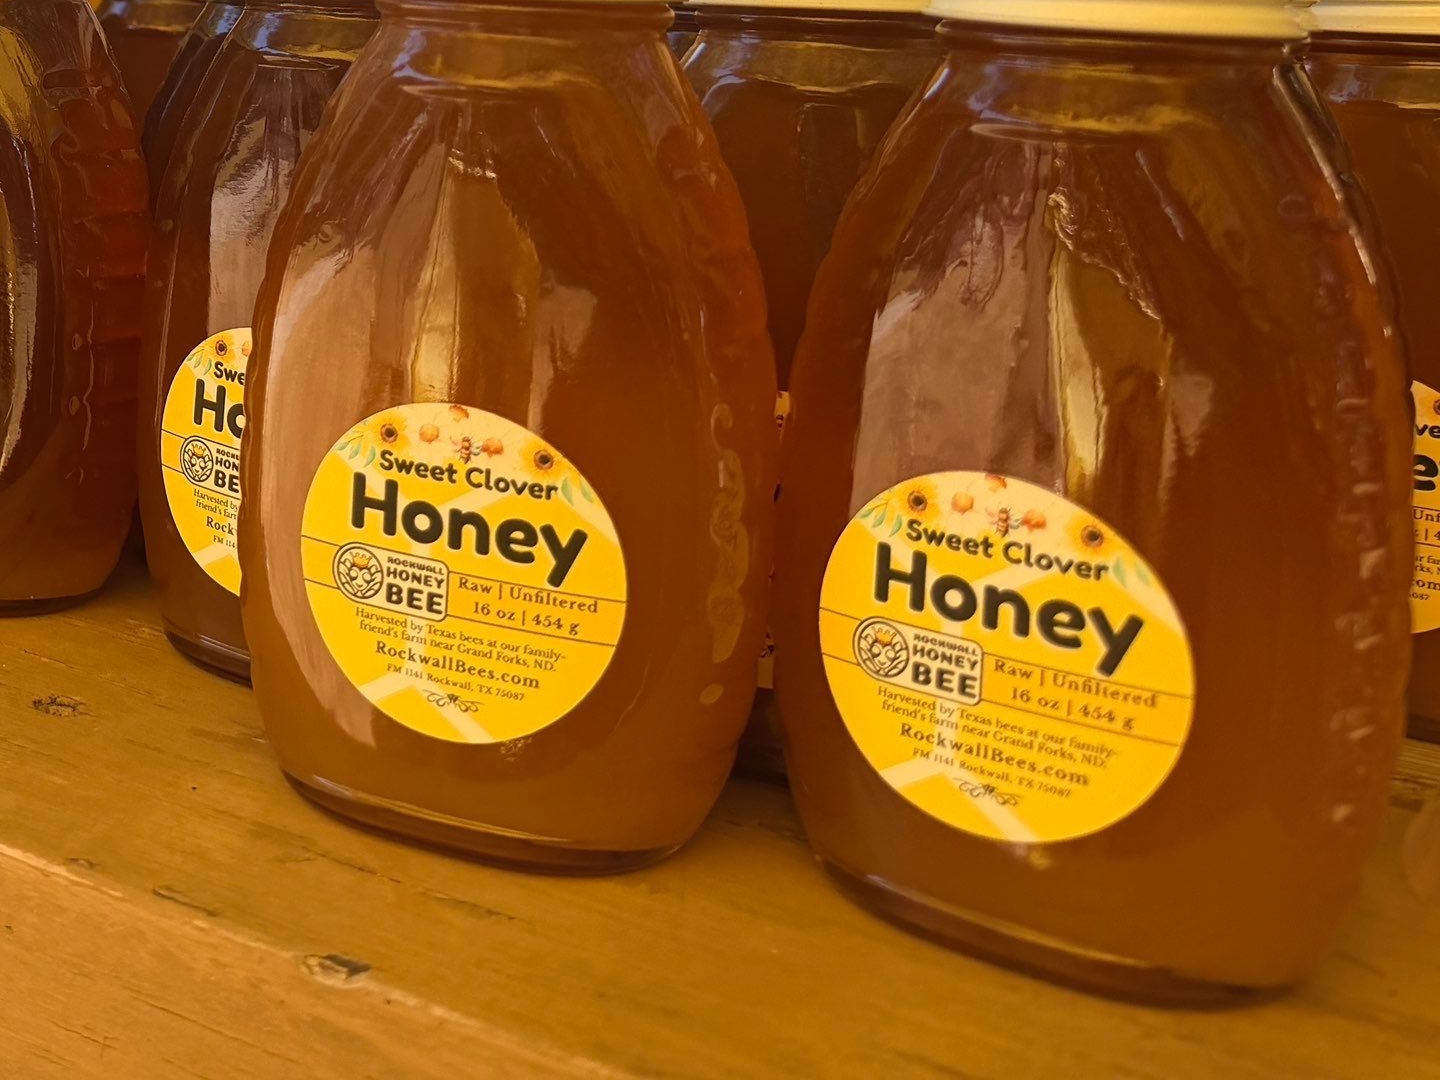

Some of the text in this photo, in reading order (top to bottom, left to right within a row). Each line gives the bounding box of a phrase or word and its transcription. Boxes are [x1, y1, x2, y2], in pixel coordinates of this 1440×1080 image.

[213, 360, 244, 385] Swe
[214, 469, 240, 493] BE
[215, 456, 241, 474] HON
[379, 449, 558, 500] Sweet Clover
[193, 488, 228, 508] Harvested
[195, 498, 222, 515] friend's
[351, 472, 588, 588] Honey
[387, 556, 444, 575] ROCKWALL
[906, 518, 1109, 581] Sweet Clover
[386, 566, 444, 589] HONEY
[458, 576, 598, 613] Raw Unfiltered
[386, 582, 443, 614] BEE
[874, 542, 1144, 677] Honey
[355, 606, 566, 663] Harvested by Texas bees at our family-
[473, 601, 579, 636] 16 oz 454 g
[359, 619, 556, 672] friend's farm near Grand Forks, ND.
[912, 644, 978, 671] HONEY
[913, 633, 977, 656] ROCKWALL
[375, 640, 539, 689] RockwallBees.com
[386, 663, 402, 673] FM
[427, 672, 473, 691] Rockwall,
[477, 684, 492, 695] TX
[912, 661, 977, 698] BEE
[994, 659, 1158, 708] Raw Unfiltered
[877, 685, 936, 712] Harvested
[959, 708, 992, 726] Texas
[1012, 687, 1031, 703] 16
[1037, 697, 1059, 710] oz
[1078, 703, 1115, 723] 454
[881, 699, 926, 721] friend's
[928, 711, 959, 730] farm
[962, 724, 990, 738] near
[992, 730, 1033, 750] Grand
[900, 722, 1088, 785] RockwallBees.com
